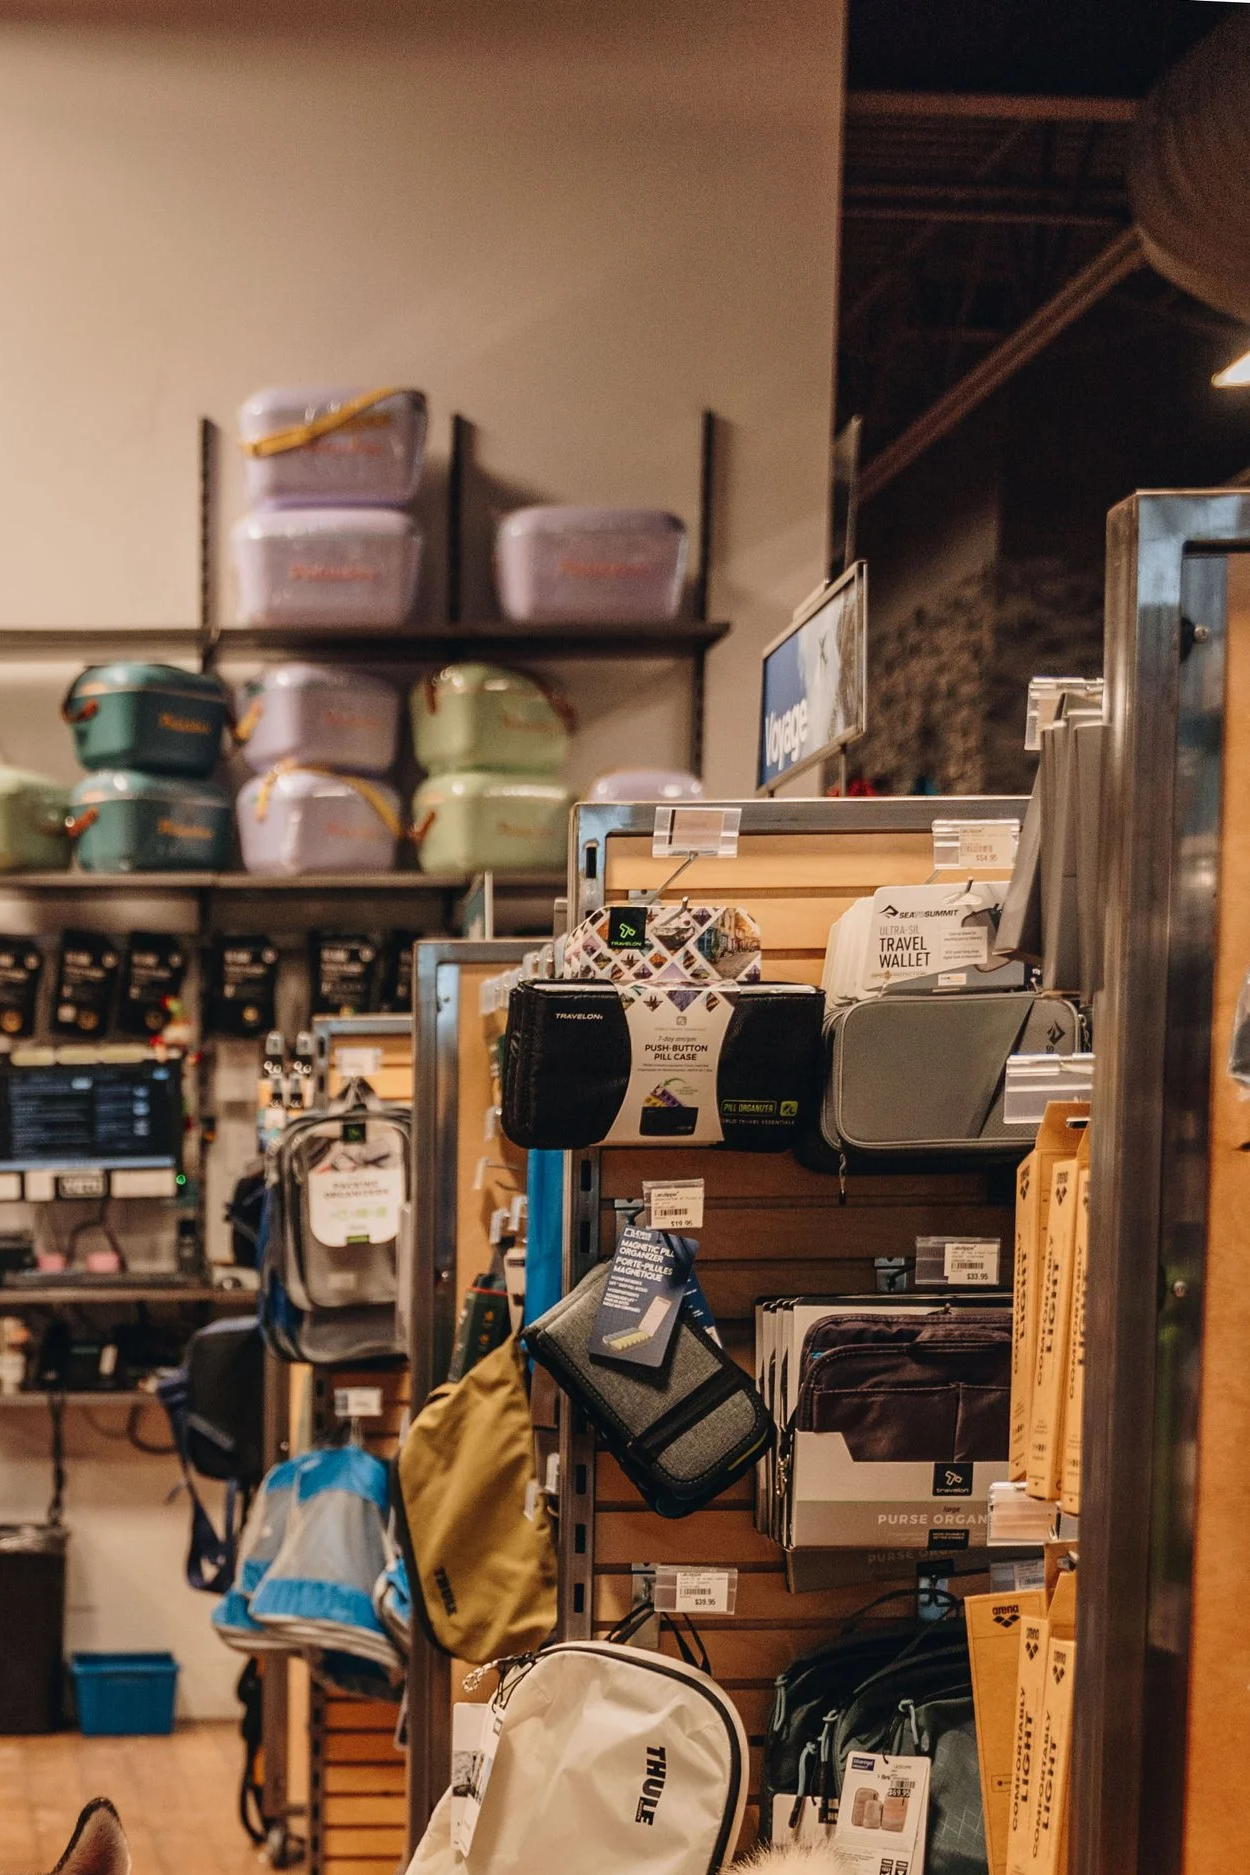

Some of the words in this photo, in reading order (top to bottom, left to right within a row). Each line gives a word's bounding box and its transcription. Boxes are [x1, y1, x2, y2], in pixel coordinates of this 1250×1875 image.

[765, 698, 808, 771] Voyage
[879, 937, 928, 952] TRAVEL
[879, 952, 931, 968] WALLET
[644, 1044, 708, 1052] PUSH-BUTTON
[654, 1053, 671, 1061] PILL
[673, 1053, 698, 1061] CASE
[619, 1247, 664, 1263] ORGANIZER
[620, 1239, 660, 1254] MAGNETIC
[660, 1247, 675, 1258] PILL
[1019, 1250, 1028, 1339] LIGHT
[1046, 1259, 1059, 1353] LIGHT
[943, 1505, 961, 1514] large
[878, 1514, 928, 1525] PURSE
[695, 1598, 716, 1606] $39.95
[992, 1604, 1019, 1615] arena
[1012, 1686, 1026, 1831] COMFORTABLY
[1020, 1710, 1033, 1803] LIGHT
[635, 1746, 667, 1826] THULE
[1032, 1709, 1051, 1858] COMFORTABLY
[1042, 1736, 1057, 1831] LIGHT
